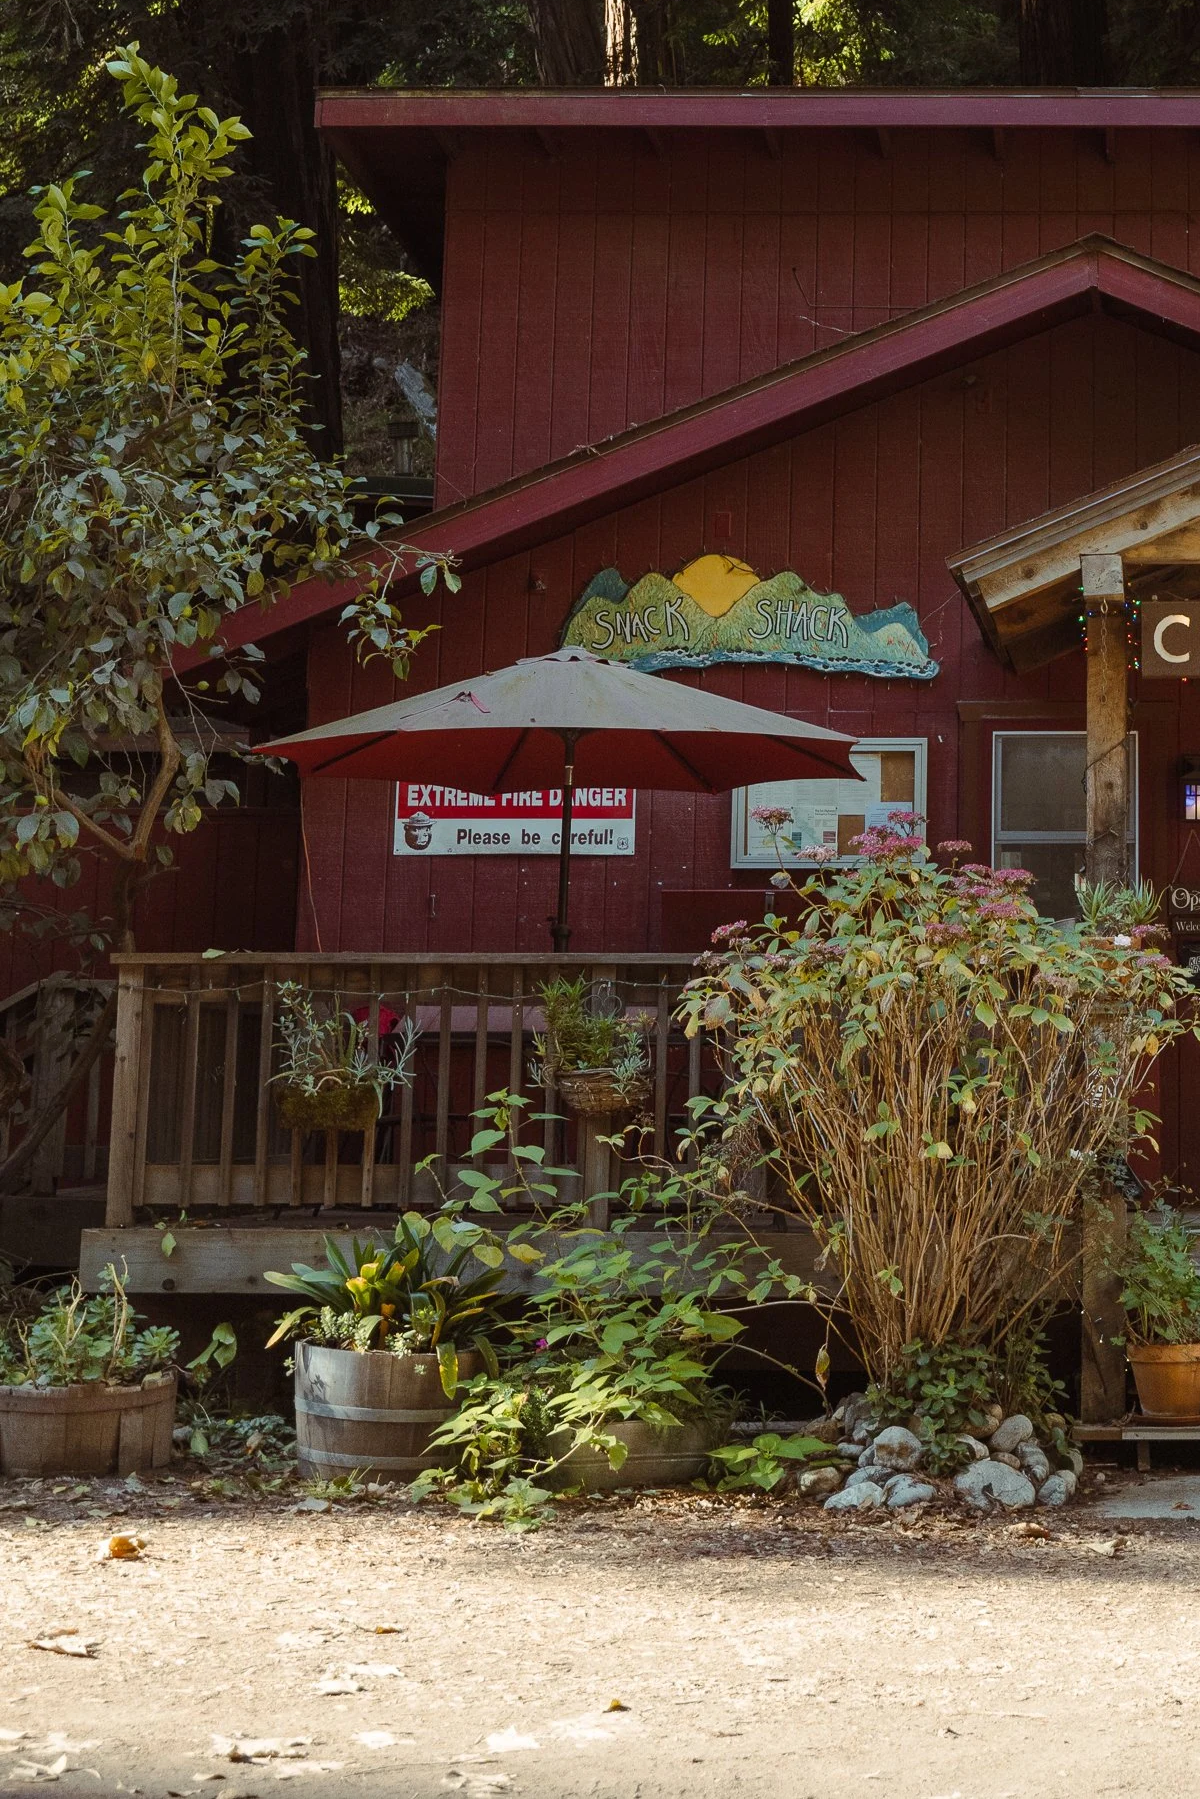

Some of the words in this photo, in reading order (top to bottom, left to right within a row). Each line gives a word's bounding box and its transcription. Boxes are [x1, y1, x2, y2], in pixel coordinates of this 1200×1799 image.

[591, 596, 690, 650] SNACK
[748, 599, 849, 648] SHACK
[501, 790, 543, 807] FIRE
[549, 787, 627, 807] DNGER
[456, 829, 511, 845] Please
[521, 829, 541, 845] be
[551, 829, 614, 845] creful!
